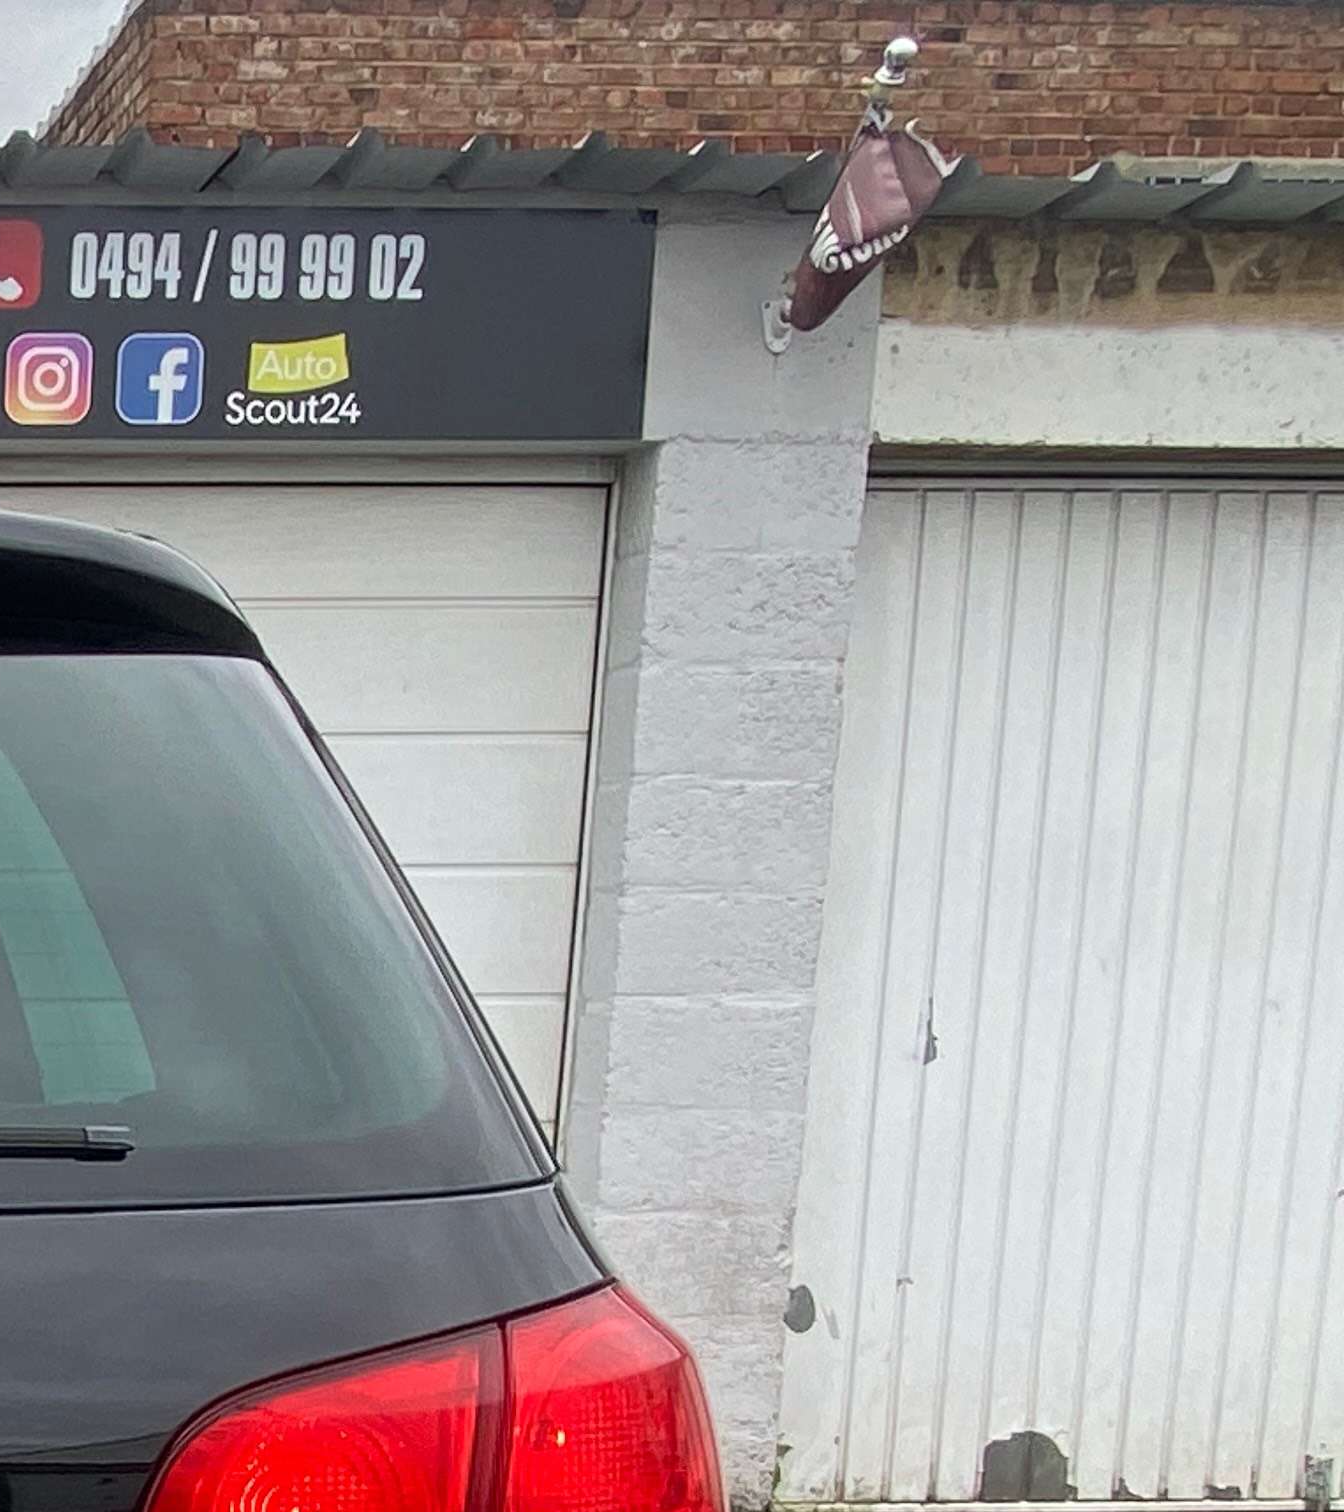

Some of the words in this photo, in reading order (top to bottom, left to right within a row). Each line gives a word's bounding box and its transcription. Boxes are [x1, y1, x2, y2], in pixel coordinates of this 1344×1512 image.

[69, 232, 182, 300] 0494
[192, 229, 219, 302] /
[229, 232, 286, 300] 99
[298, 233, 355, 300] 99
[368, 234, 426, 300] 02
[255, 348, 338, 382] Auto
[224, 391, 362, 425] Scout24
